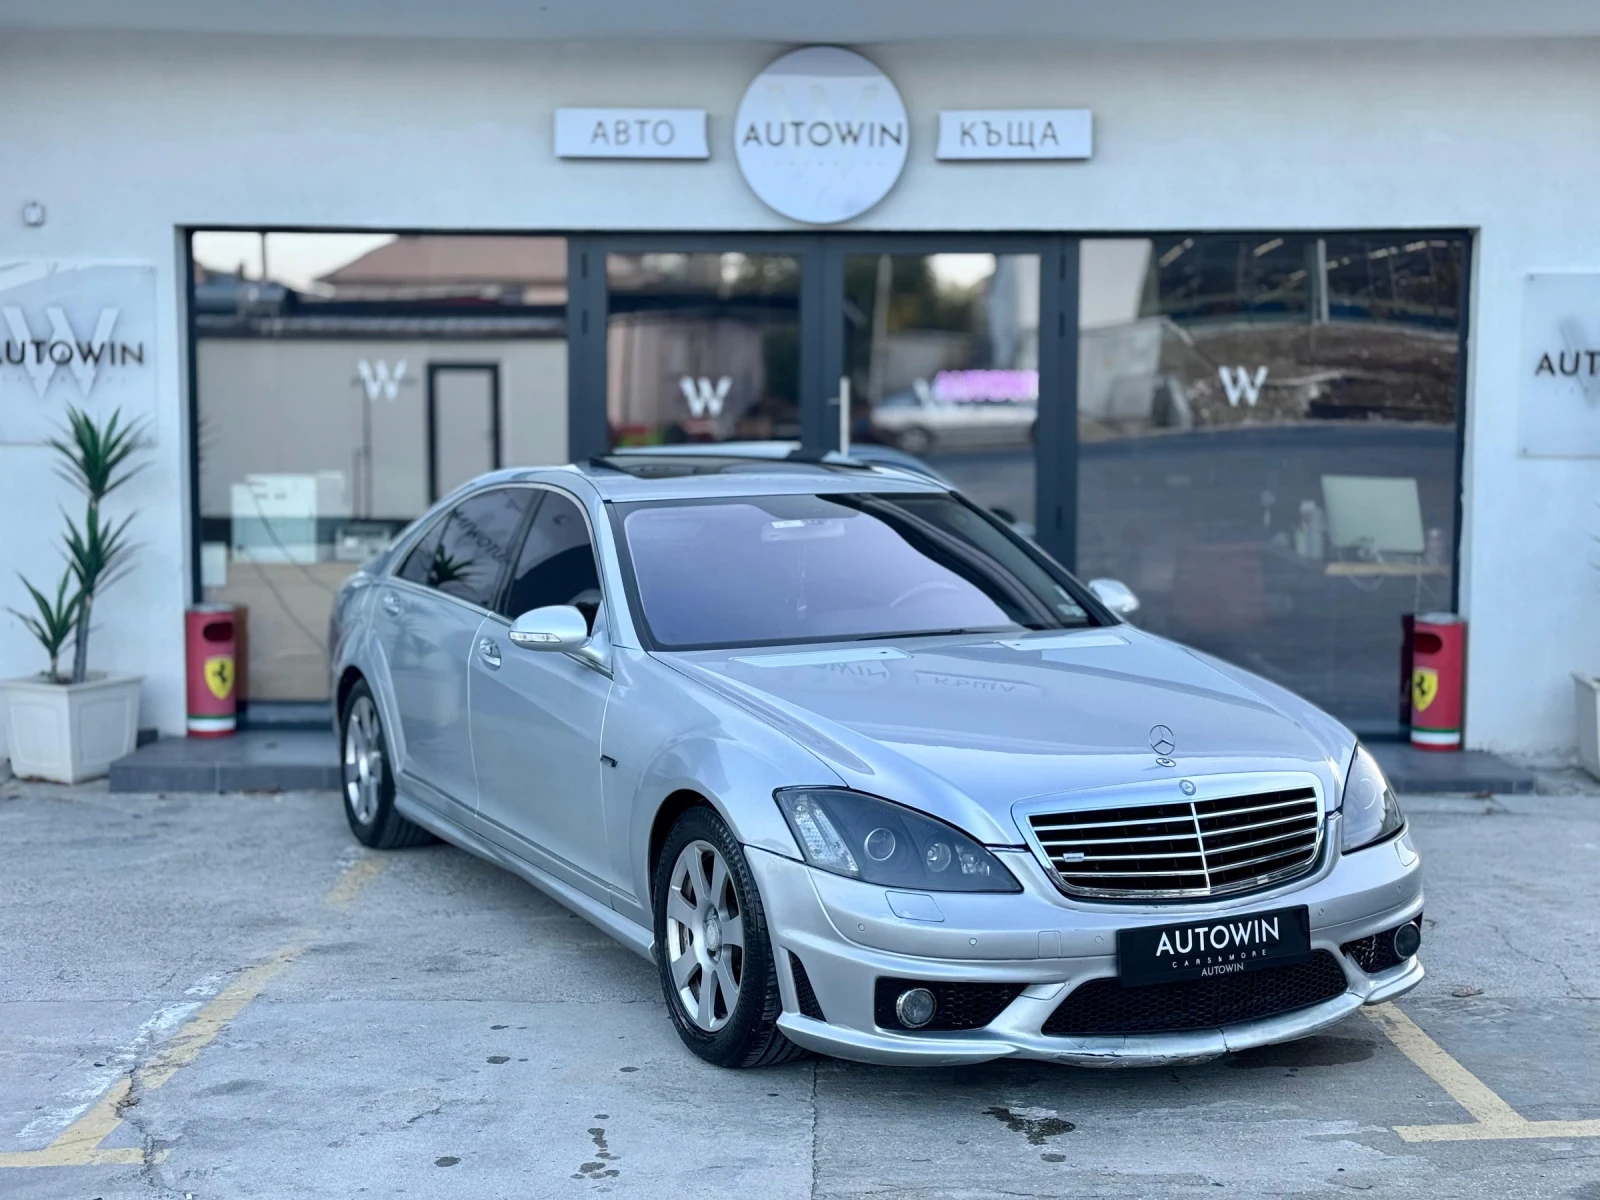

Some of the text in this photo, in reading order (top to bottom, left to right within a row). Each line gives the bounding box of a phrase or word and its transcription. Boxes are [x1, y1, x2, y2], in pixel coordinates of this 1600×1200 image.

[588, 118, 676, 146] АВТО
[742, 120, 904, 147] AUTOWIN
[958, 118, 1061, 151] КЪЩА
[0, 340, 144, 367] UTOWIN
[1534, 350, 1600, 377] AUT
[357, 358, 407, 402] W
[1218, 365, 1269, 407] W
[680, 375, 732, 417] W
[1155, 916, 1280, 957] AUTOWIN
[1201, 962, 1245, 977] AUTOWIN
